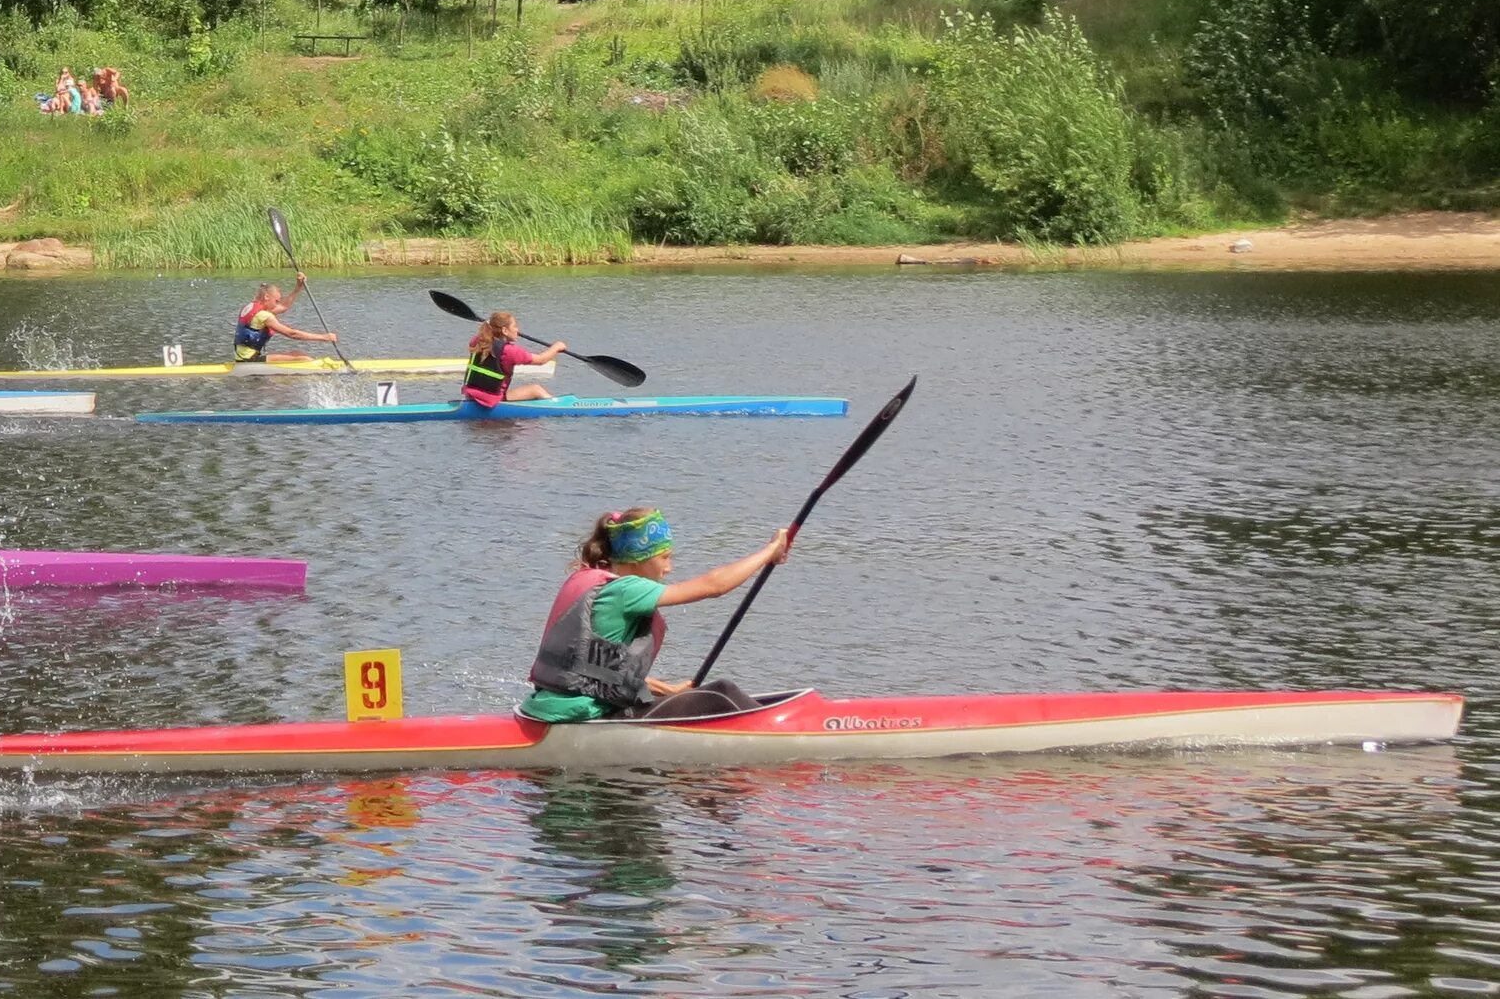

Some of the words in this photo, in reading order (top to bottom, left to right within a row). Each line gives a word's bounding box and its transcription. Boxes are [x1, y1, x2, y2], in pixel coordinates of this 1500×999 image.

[167, 346, 178, 364] 6
[377, 382, 393, 403] 7
[361, 661, 387, 709] 9
